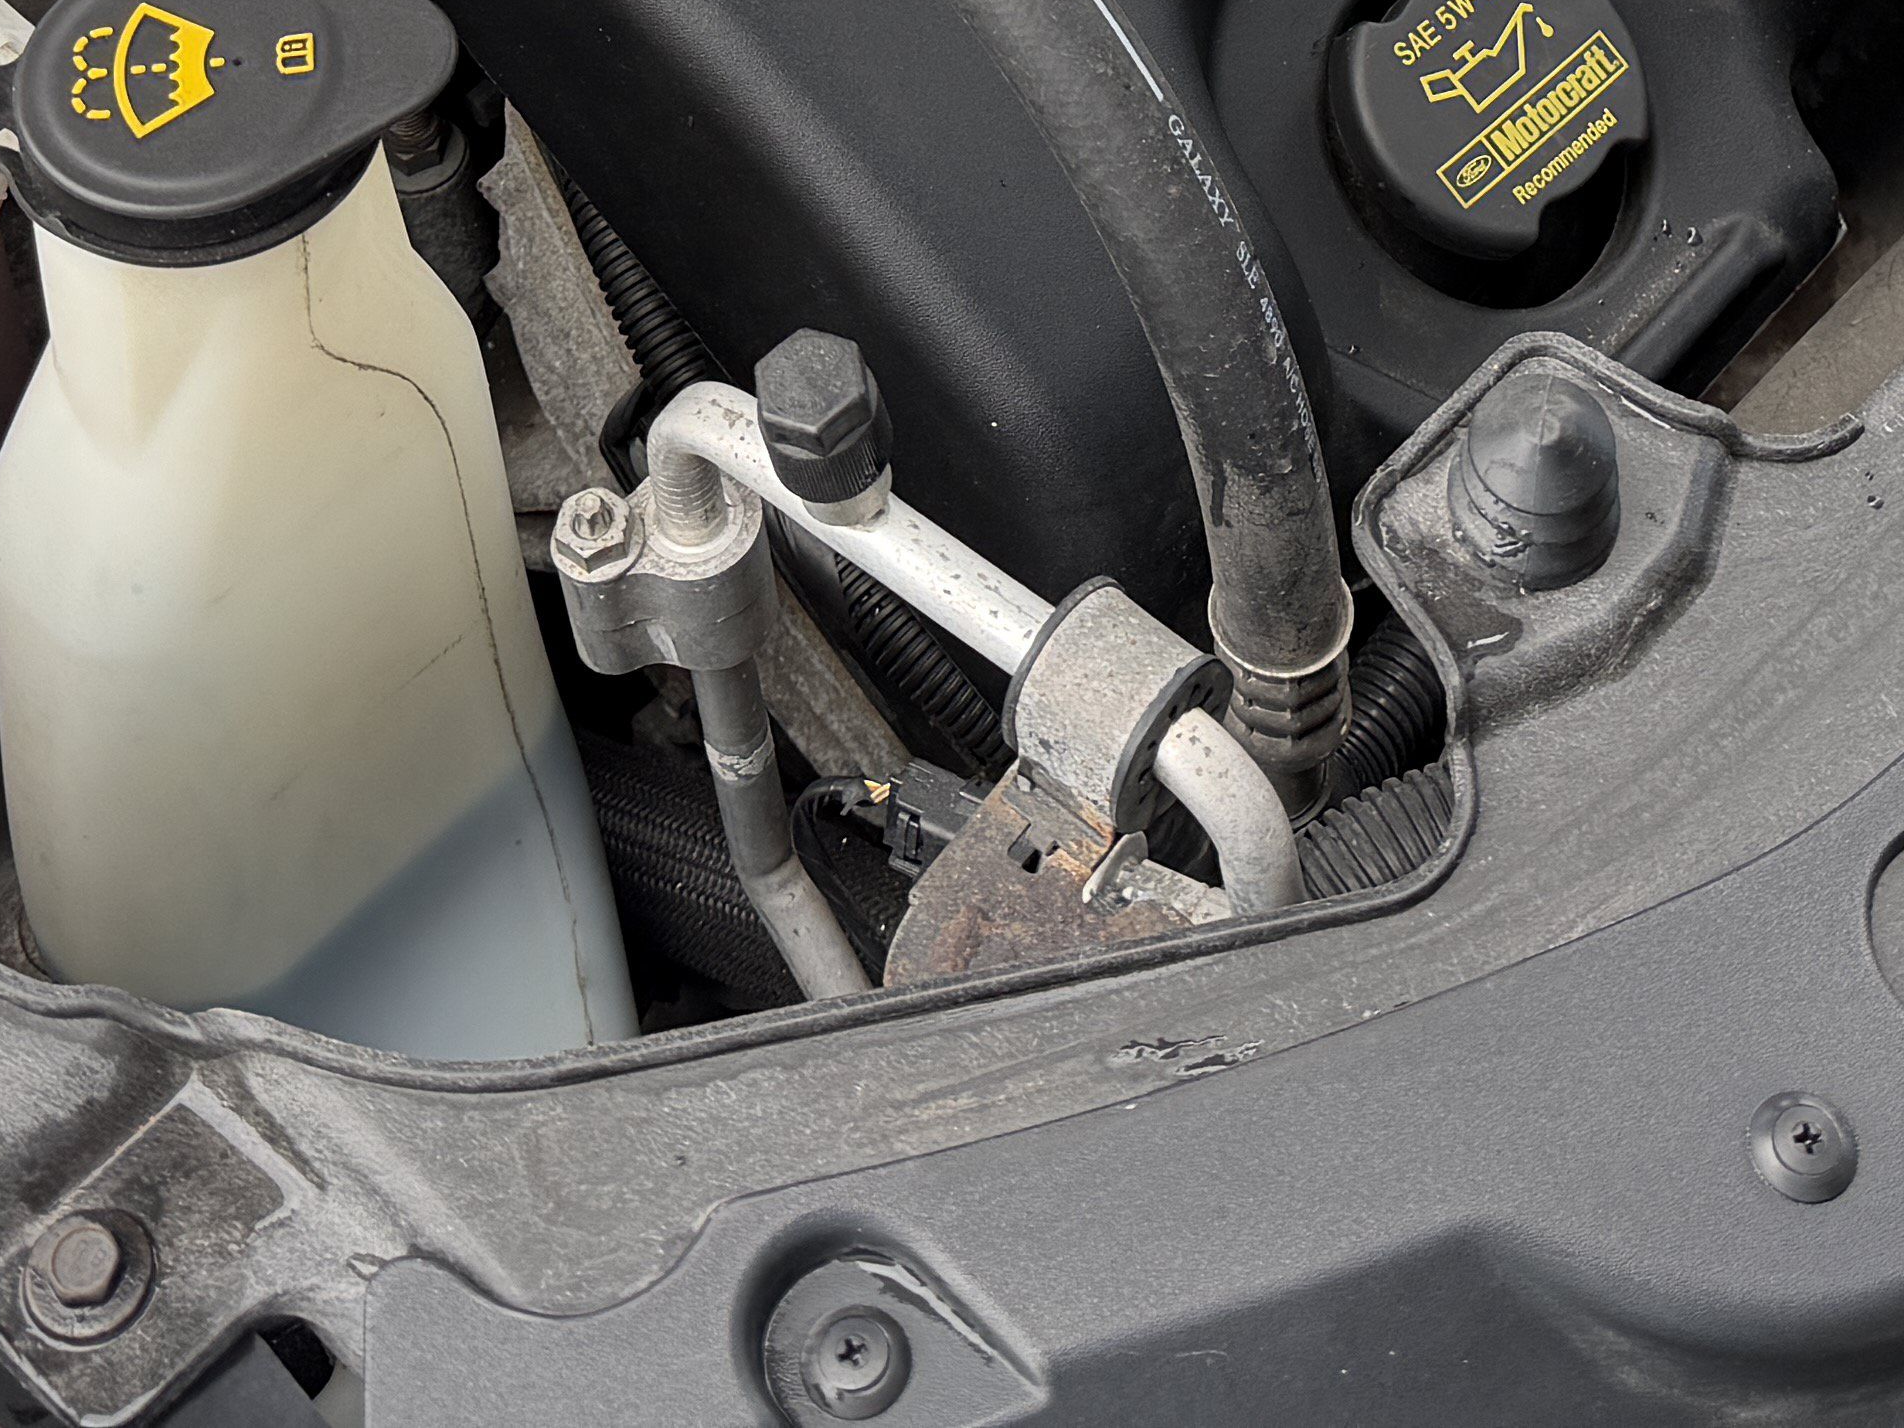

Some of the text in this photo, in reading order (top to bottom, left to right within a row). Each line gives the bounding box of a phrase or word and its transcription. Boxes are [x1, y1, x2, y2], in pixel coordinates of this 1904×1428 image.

[1393, 20, 1442, 66] SAE
[1490, 44, 1620, 162] Motorcraft
[1512, 107, 1619, 205] Recommended
[1166, 113, 1235, 228] GALAXY
